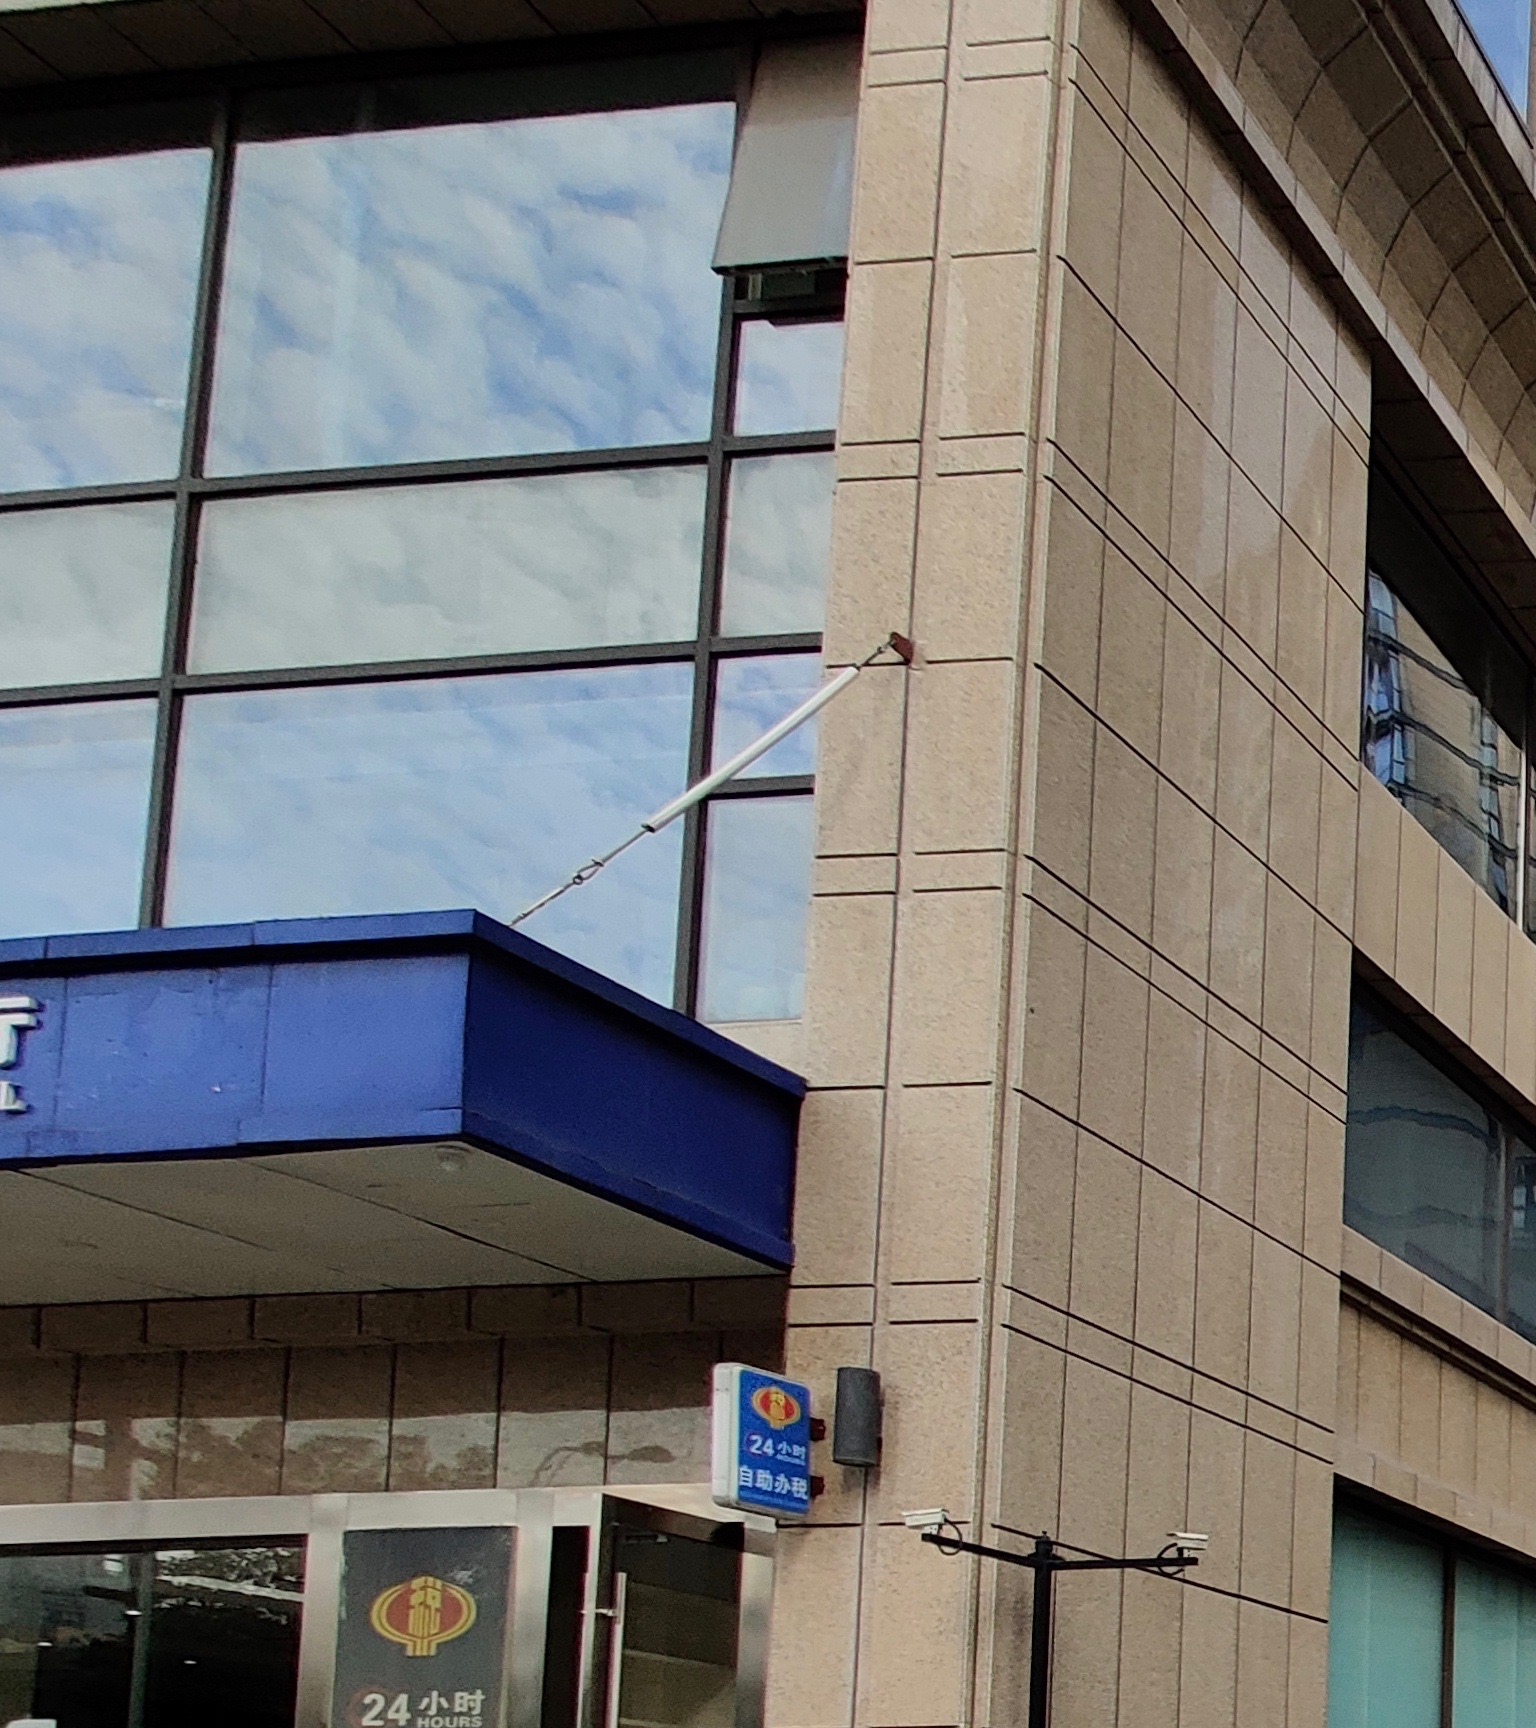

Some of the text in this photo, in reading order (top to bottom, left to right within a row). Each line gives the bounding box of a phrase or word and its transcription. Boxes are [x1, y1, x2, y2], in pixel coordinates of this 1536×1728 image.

[739, 1466, 808, 1499] 自助办税
[416, 1716, 482, 1728] HOURS
